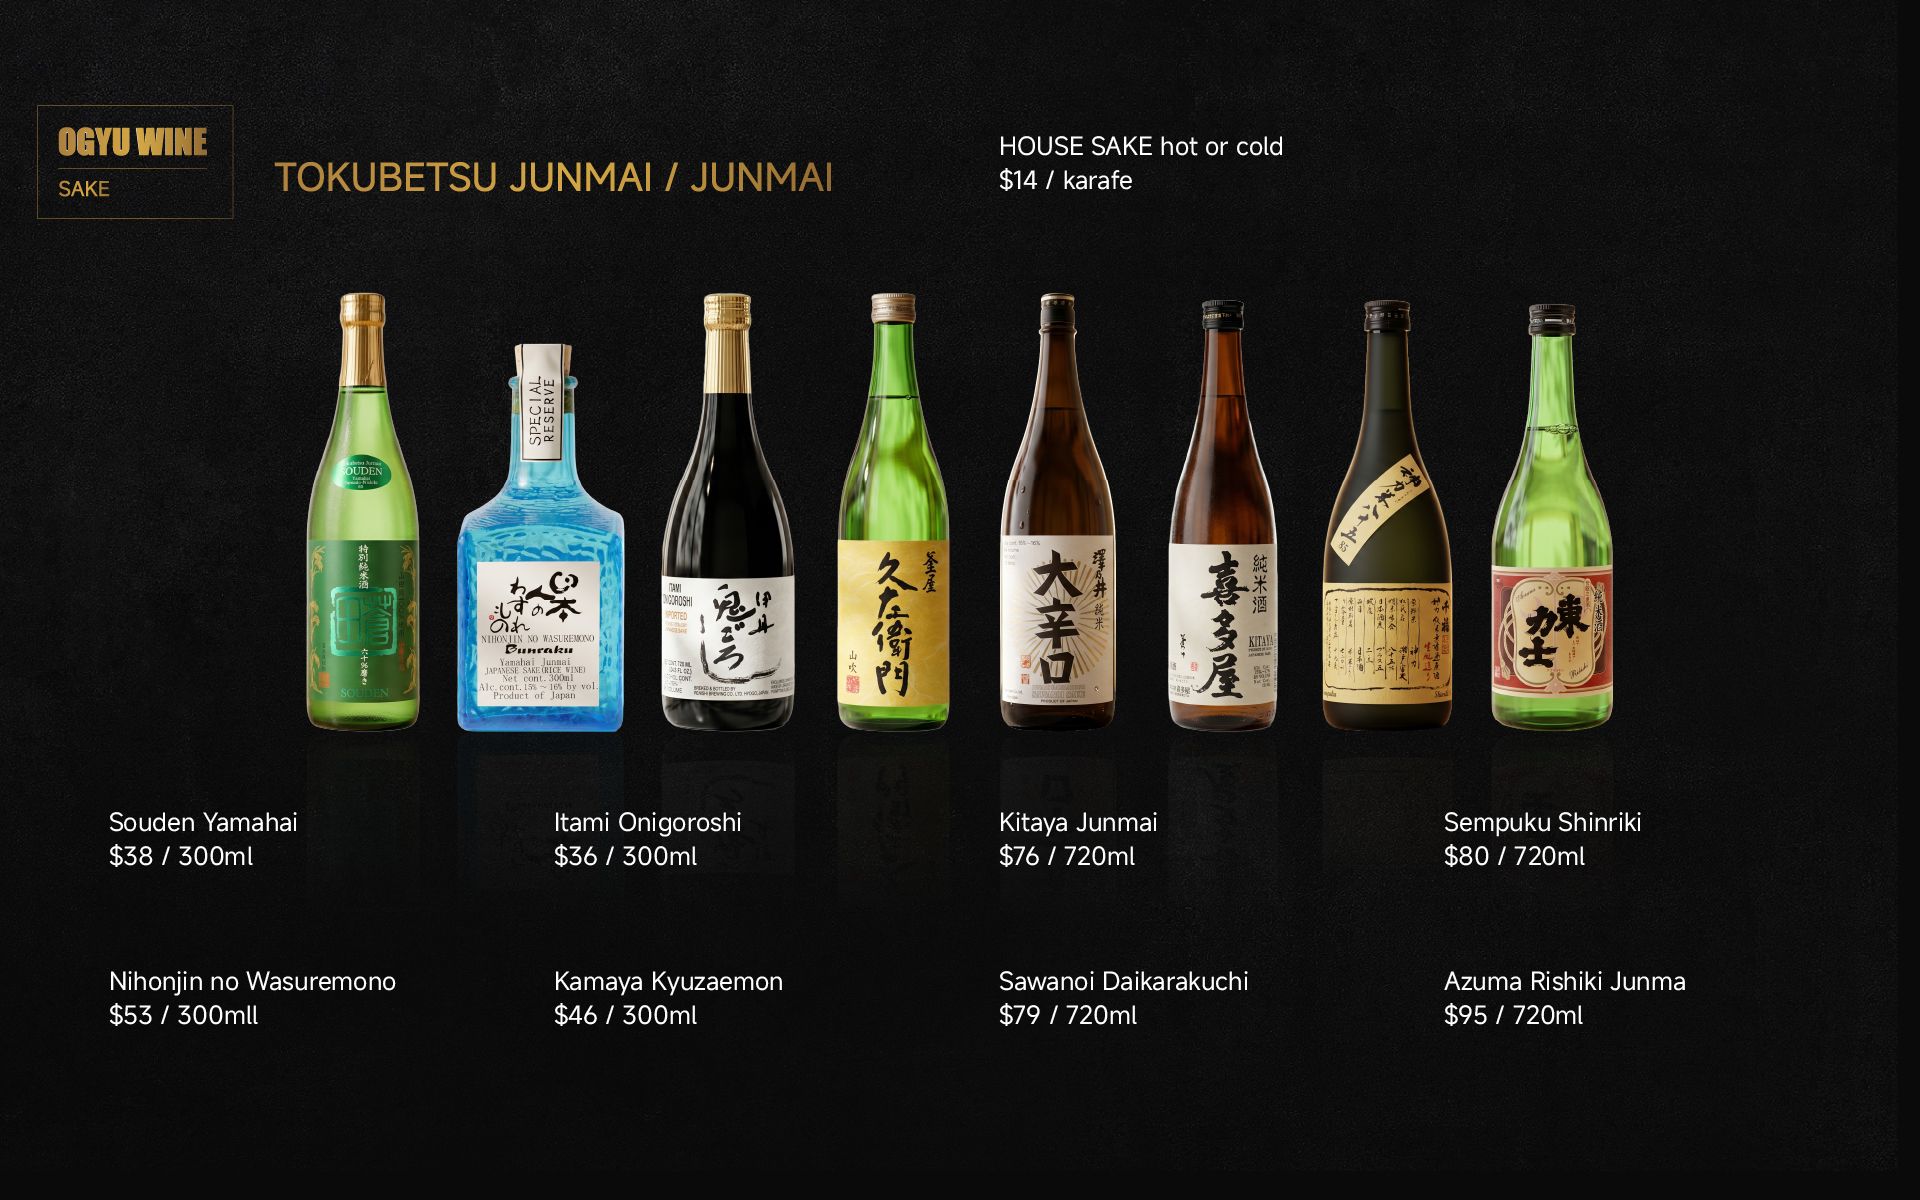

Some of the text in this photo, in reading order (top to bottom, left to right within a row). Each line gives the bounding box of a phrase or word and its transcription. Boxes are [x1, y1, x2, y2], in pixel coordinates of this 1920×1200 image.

[529, 375, 542, 446] SPECIAL
[543, 379, 555, 442] RESERVE
[342, 466, 383, 476] OUDEN
[1338, 540, 1350, 553] 85
[1252, 554, 1268, 615] 純米酒
[1033, 549, 1084, 685] 大辛口
[1094, 603, 1105, 631] 純米
[872, 551, 919, 698] 久左衛門
[1200, 551, 1250, 699] 喜多屋
[481, 634, 596, 645] NIHONJIN NO WASUREMONO
[1248, 634, 1273, 648] KITAYA
[505, 643, 574, 654] Bunraku
[499, 658, 571, 667] Yamahai Junmai
[484, 666, 519, 675] JAPANESE
[502, 674, 517, 683] Net
[340, 688, 391, 698] SOUDEN
[493, 691, 576, 701] Product of Japan
